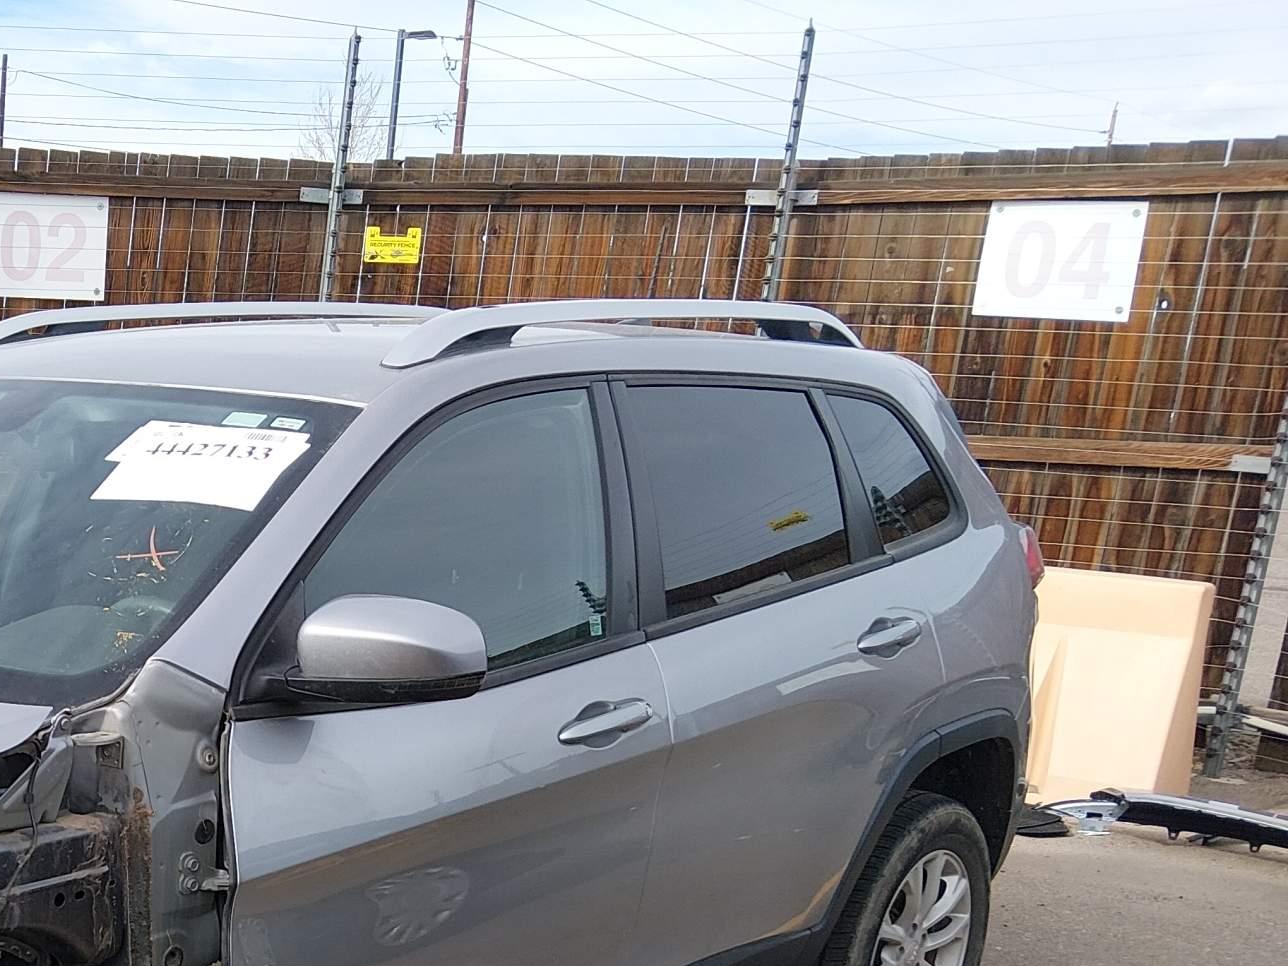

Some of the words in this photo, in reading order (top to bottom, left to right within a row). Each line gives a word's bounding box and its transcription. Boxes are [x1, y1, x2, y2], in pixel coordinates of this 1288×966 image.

[1, 210, 87, 282] 02
[1005, 220, 1111, 300] 04
[146, 442, 273, 460] 44427133
